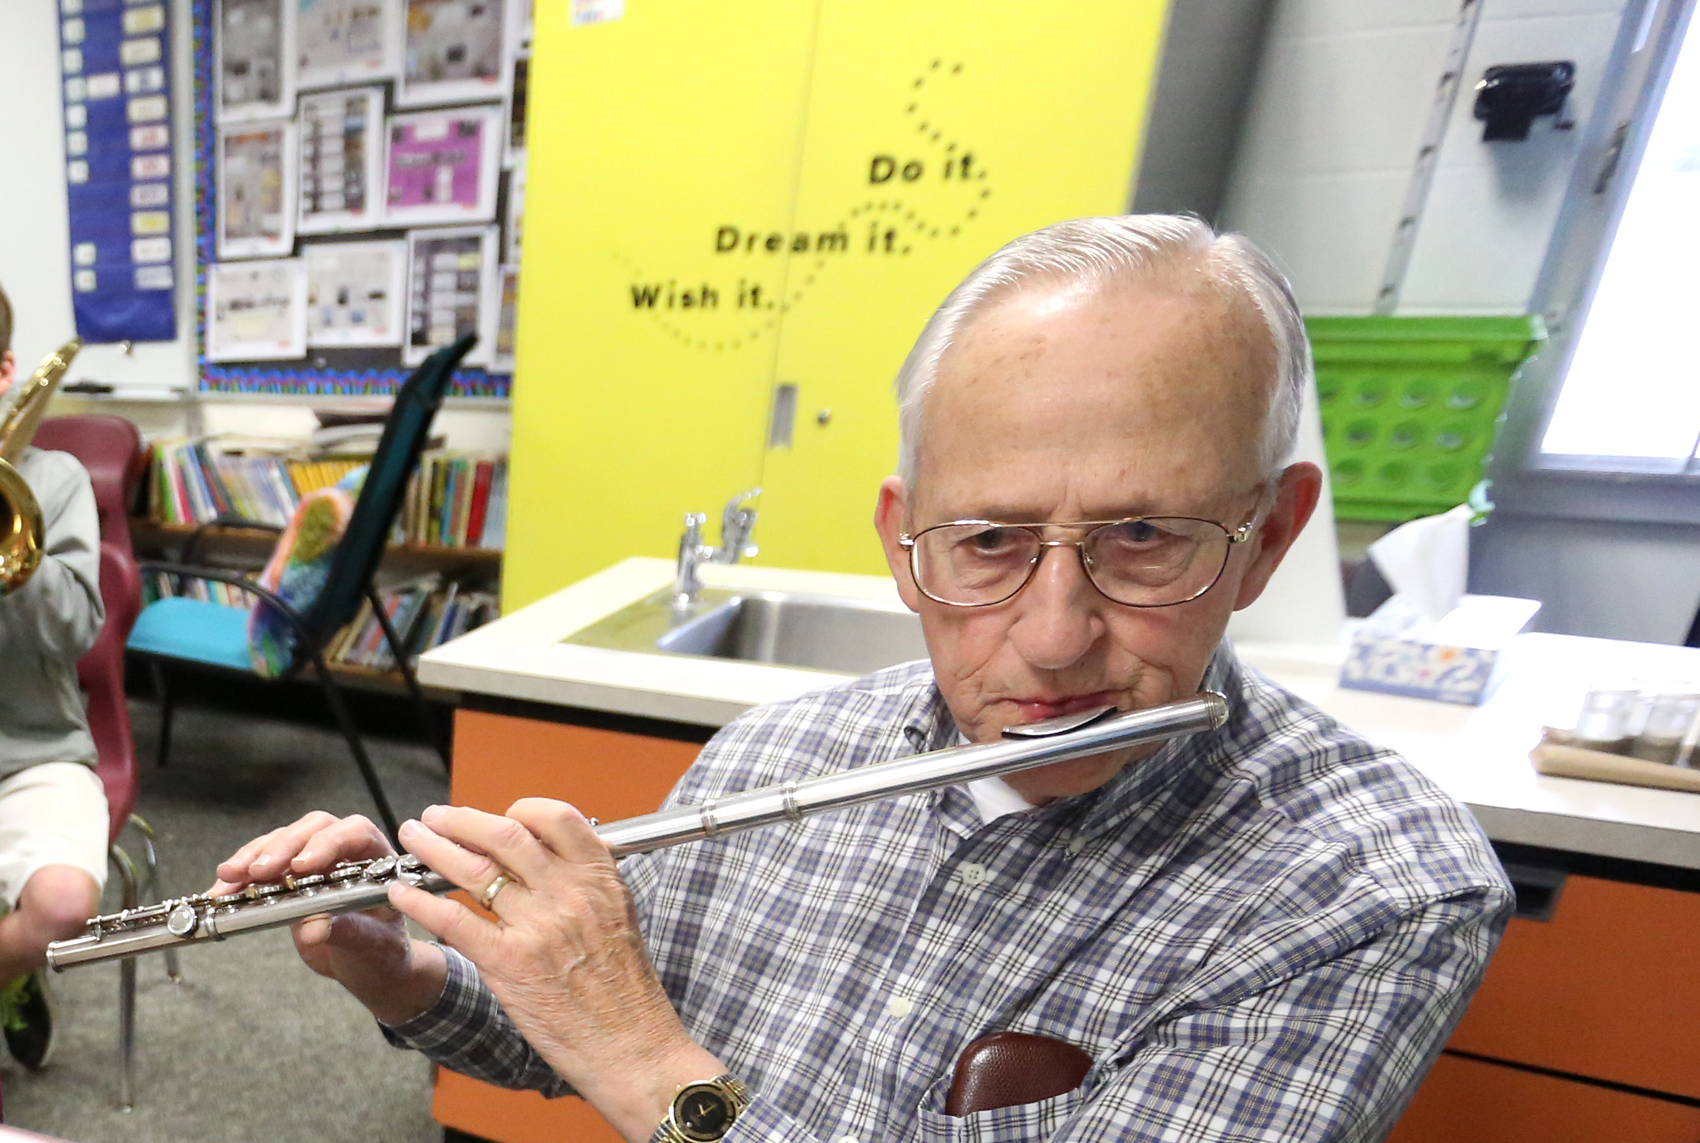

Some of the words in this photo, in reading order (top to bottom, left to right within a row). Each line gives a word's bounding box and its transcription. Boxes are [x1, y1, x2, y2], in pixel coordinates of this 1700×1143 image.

[868, 155, 925, 185] Do
[943, 143, 986, 181] it.
[714, 226, 849, 254] Dream
[867, 222, 911, 254] it.
[630, 277, 719, 309] Wish
[737, 278, 775, 310] it.
